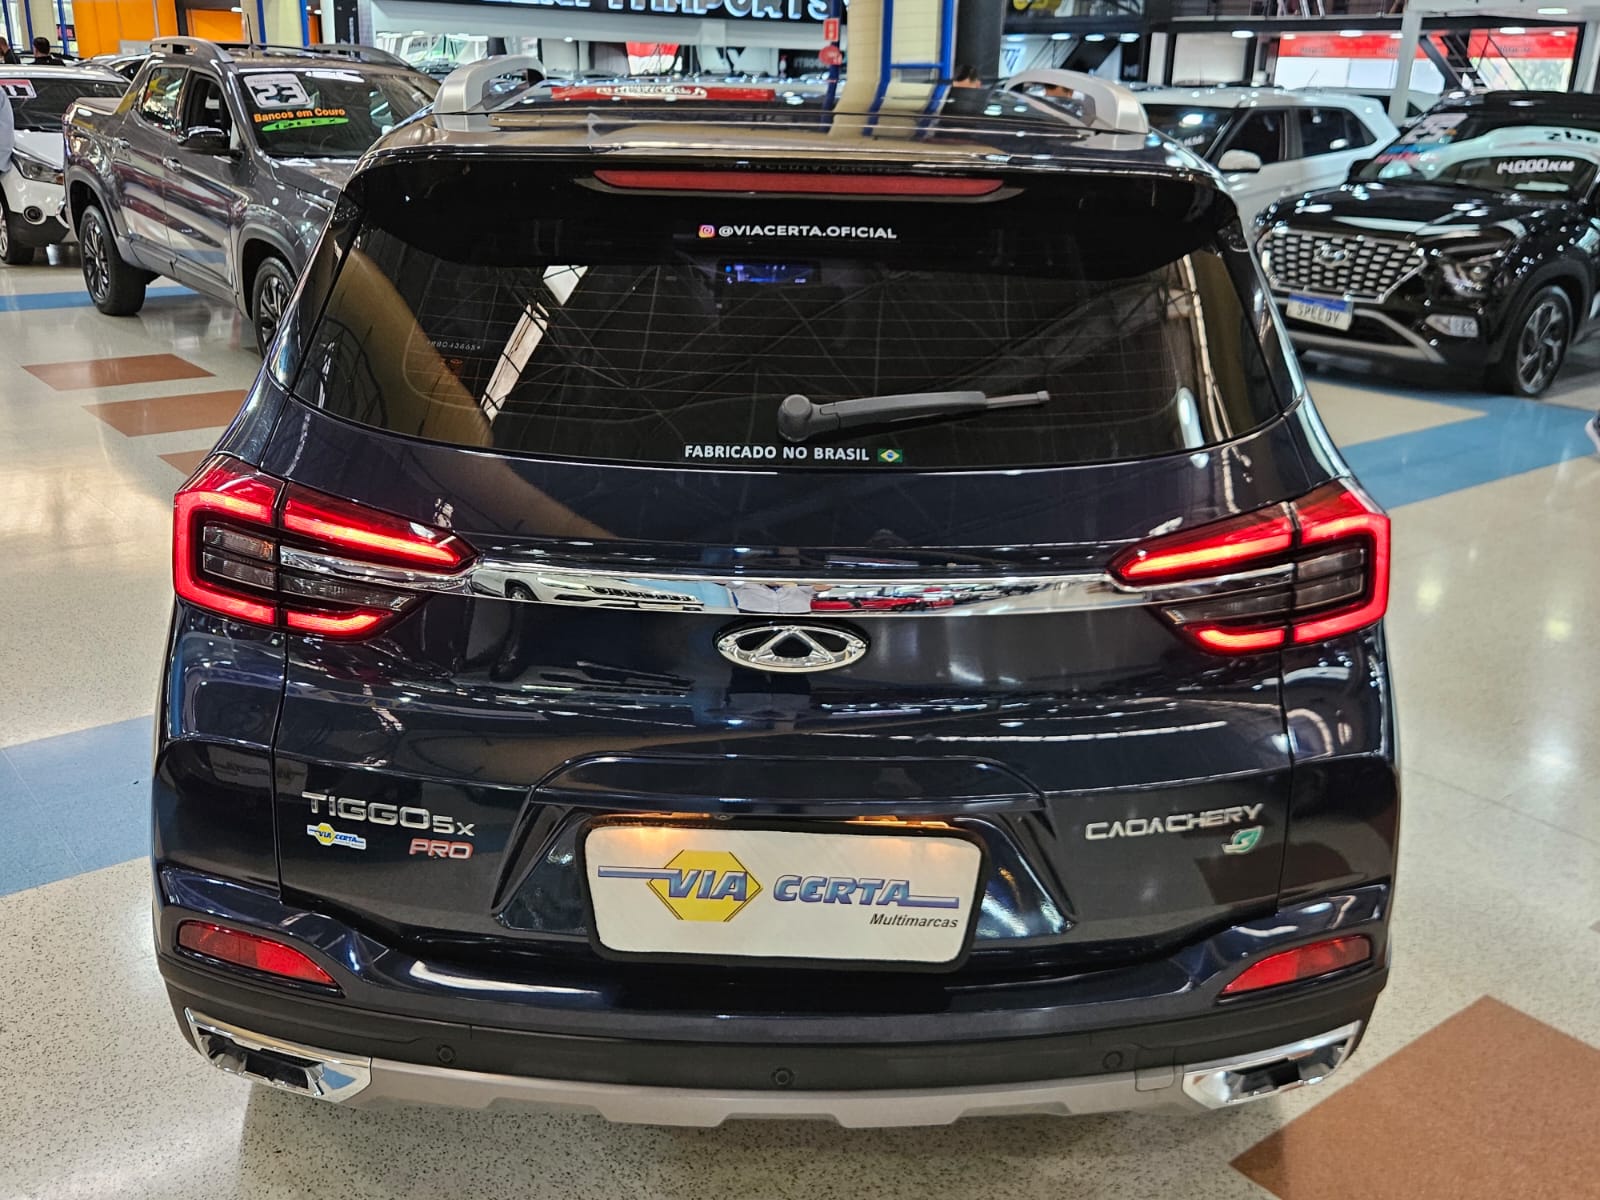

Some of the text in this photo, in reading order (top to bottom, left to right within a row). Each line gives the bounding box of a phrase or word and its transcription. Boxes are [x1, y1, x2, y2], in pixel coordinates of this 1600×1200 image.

[252, 83, 307, 105] 23
[254, 111, 294, 123] Bancos
[314, 107, 346, 116] Couro
[718, 225, 897, 239] @VIACERTA.OFICIAL
[684, 444, 870, 461] FABRICADO NO BRASIL
[409, 837, 474, 859] PRO
[667, 868, 911, 906] VIA CERTA
[869, 912, 959, 929] Multimarcas
